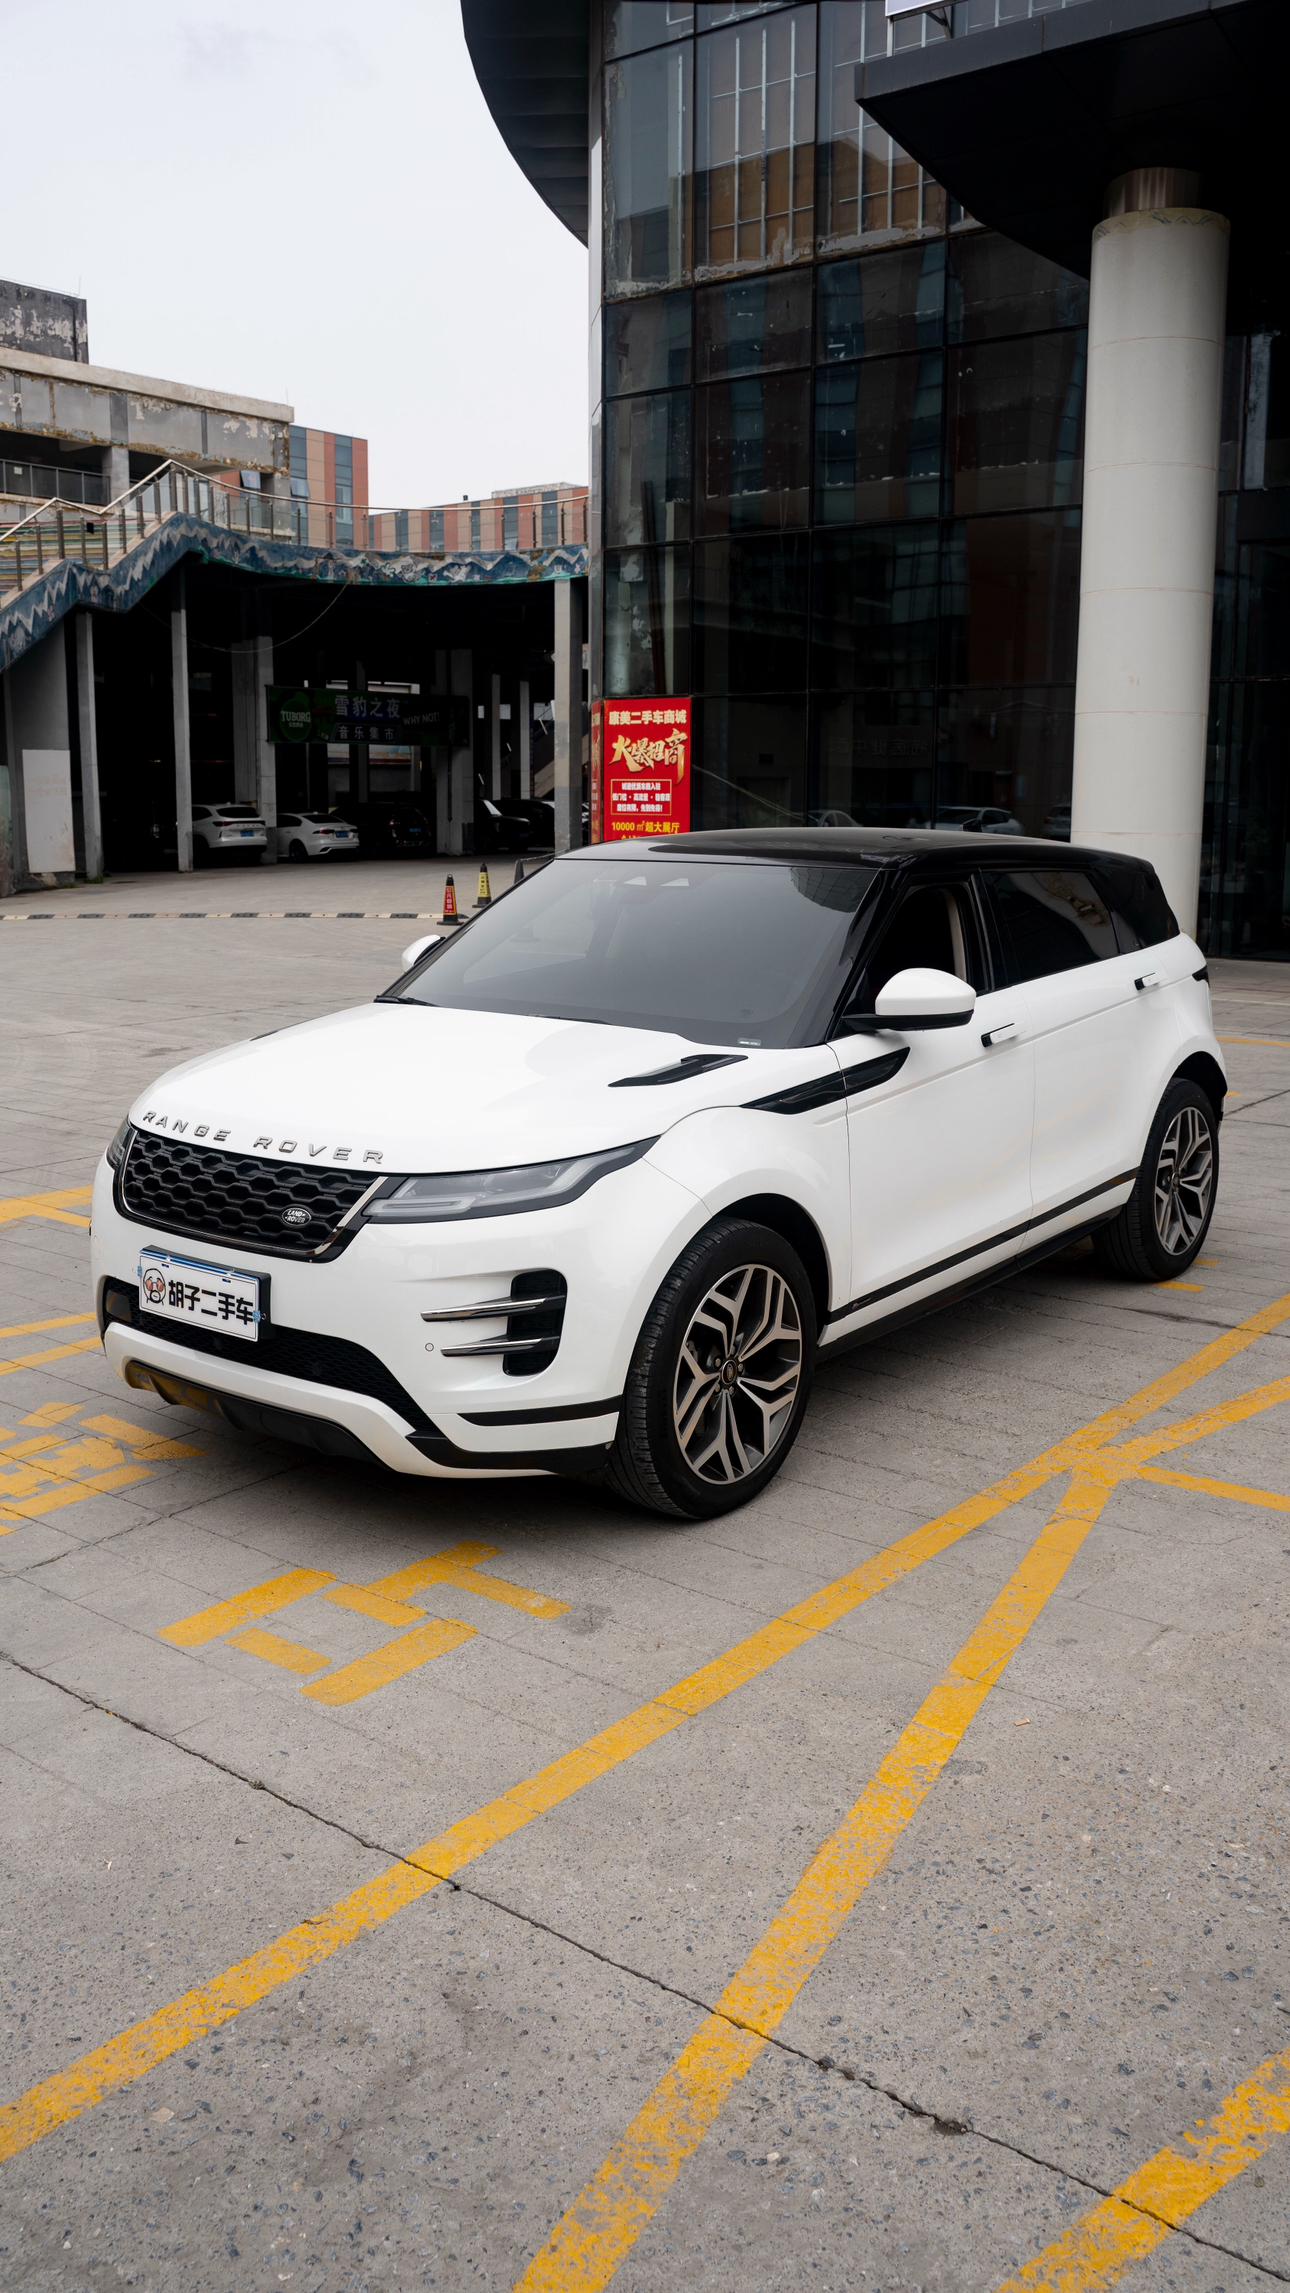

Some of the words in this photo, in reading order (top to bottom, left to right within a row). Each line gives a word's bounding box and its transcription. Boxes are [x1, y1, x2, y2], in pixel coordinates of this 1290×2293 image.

[335, 695, 401, 719] 雪豹之夜
[280, 710, 311, 722] TUBORG
[338, 725, 395, 741] 音乐集市
[611, 821, 635, 831] 10000
[143, 1110, 231, 1142] RANGE
[253, 1136, 384, 1164] ROVER
[287, 1209, 303, 1217] LAND
[287, 1215, 306, 1224] ROVER
[168, 1280, 254, 1325] 胡子二手车
